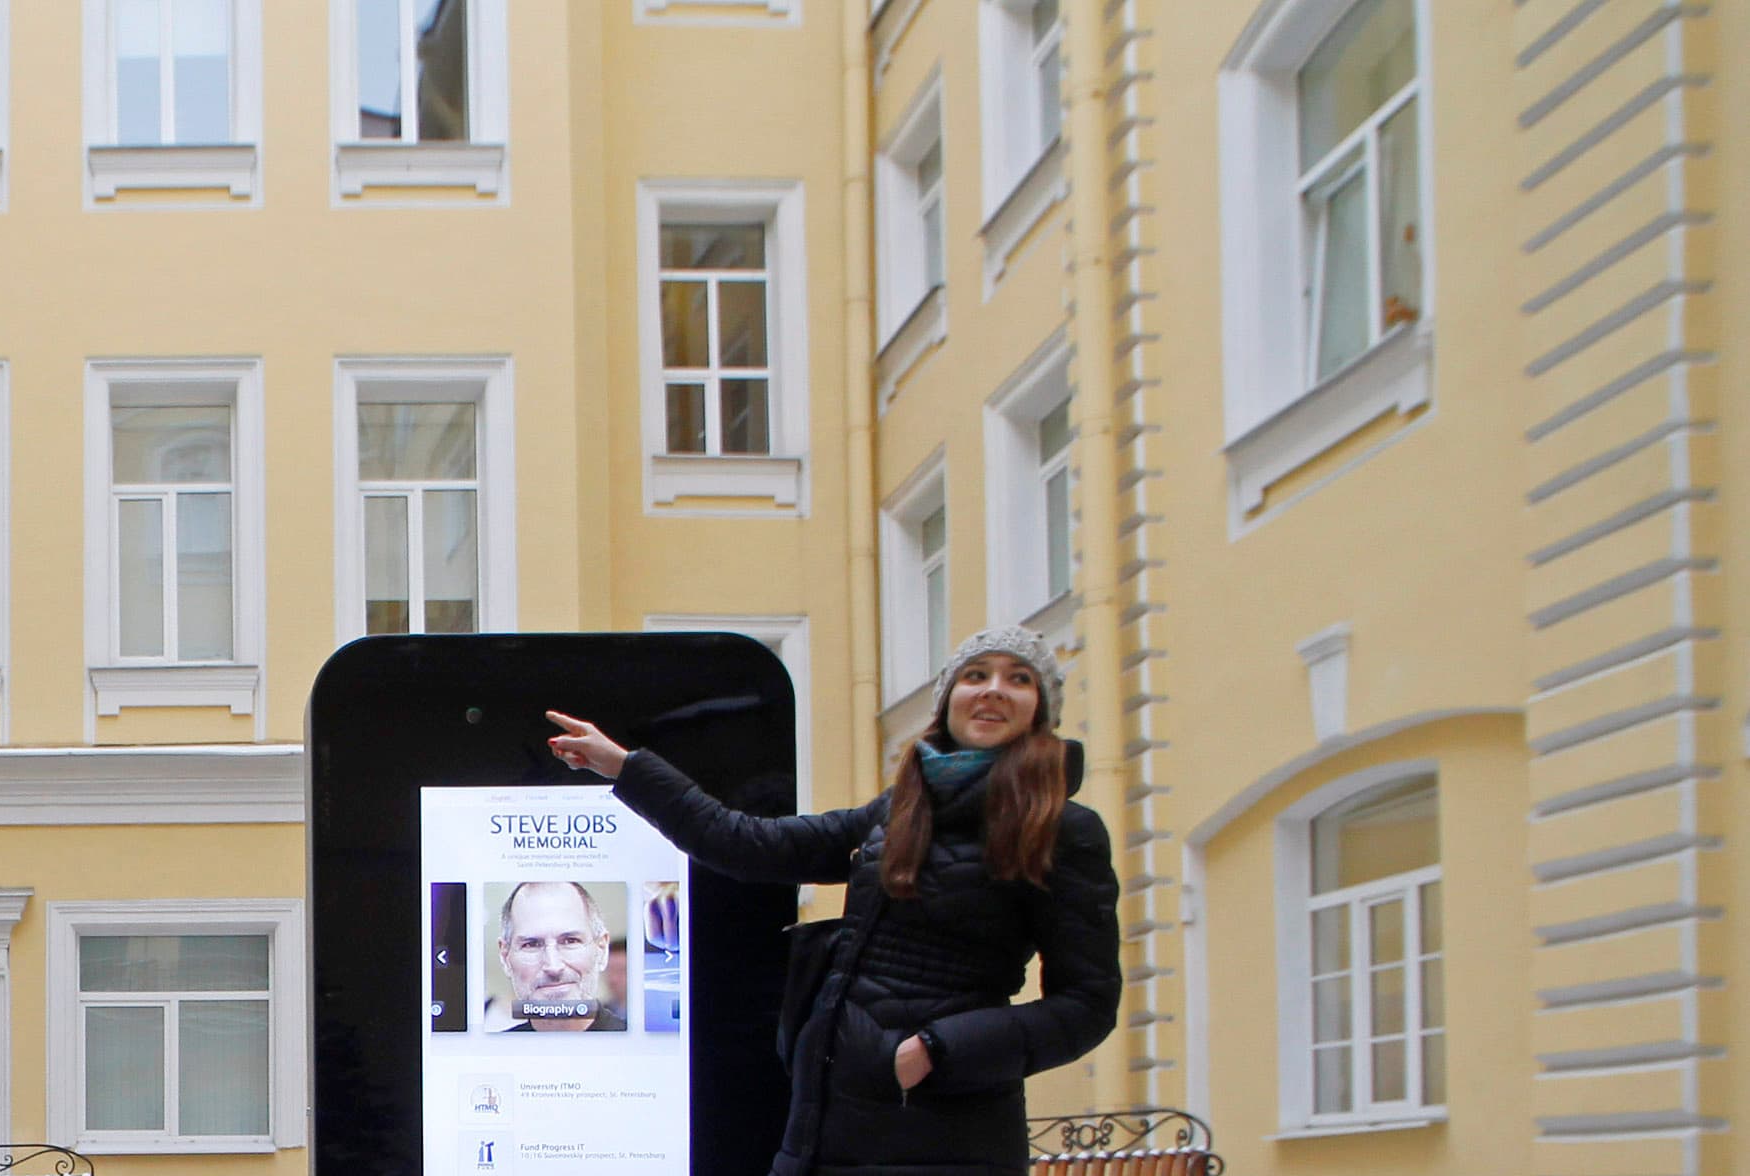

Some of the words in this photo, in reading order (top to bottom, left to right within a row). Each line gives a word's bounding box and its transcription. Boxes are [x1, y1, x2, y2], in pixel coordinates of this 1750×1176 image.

[490, 814, 559, 834] STEVE
[562, 814, 618, 835] JOBS
[513, 836, 598, 849] MEMORIAL
[523, 1003, 574, 1016] Biography
[520, 1082, 559, 1091] University
[560, 1082, 581, 1090] ITMO
[520, 1143, 540, 1151] Fund
[541, 1143, 575, 1152] Progress
[577, 1143, 585, 1151] IT
